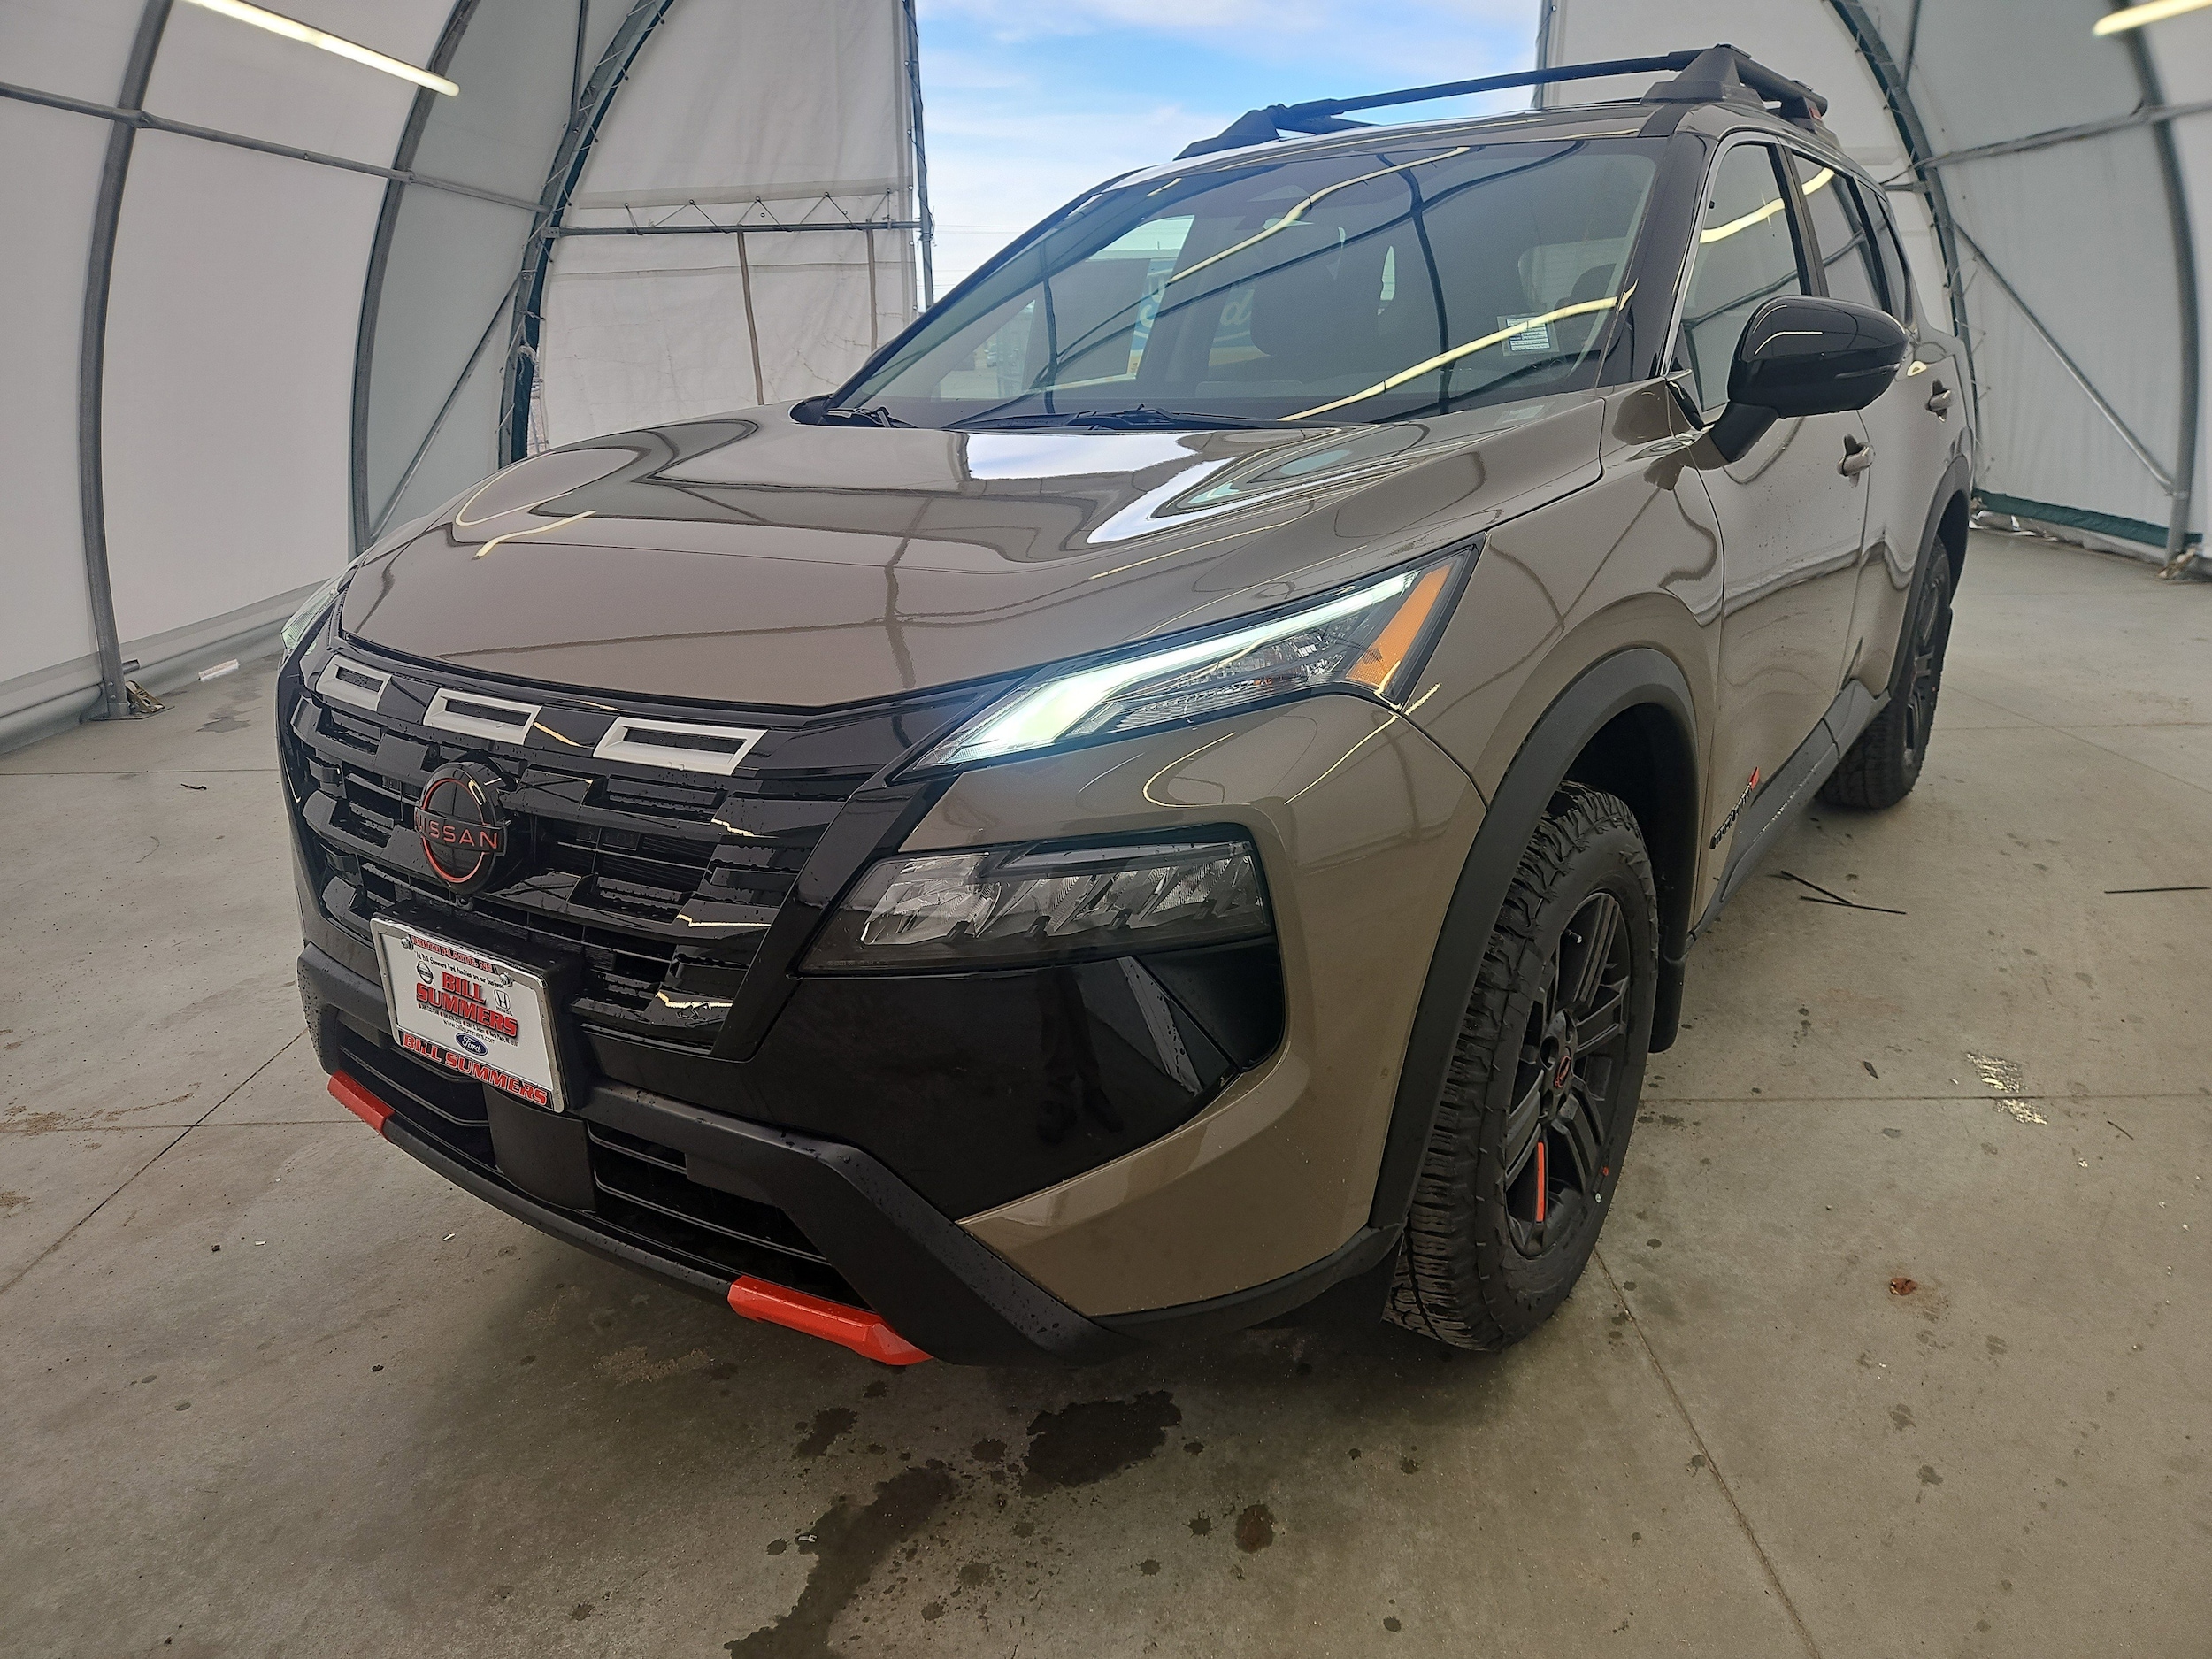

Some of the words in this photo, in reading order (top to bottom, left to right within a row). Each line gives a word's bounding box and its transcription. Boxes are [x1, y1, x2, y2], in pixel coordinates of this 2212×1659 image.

[479, 960, 494, 973] NE
[442, 971, 486, 1003] BILL
[416, 982, 518, 1037] SUMMERS
[461, 1035, 482, 1053] Ford
[403, 1033, 442, 1062] BILL
[445, 1049, 547, 1106] SUMMERS
